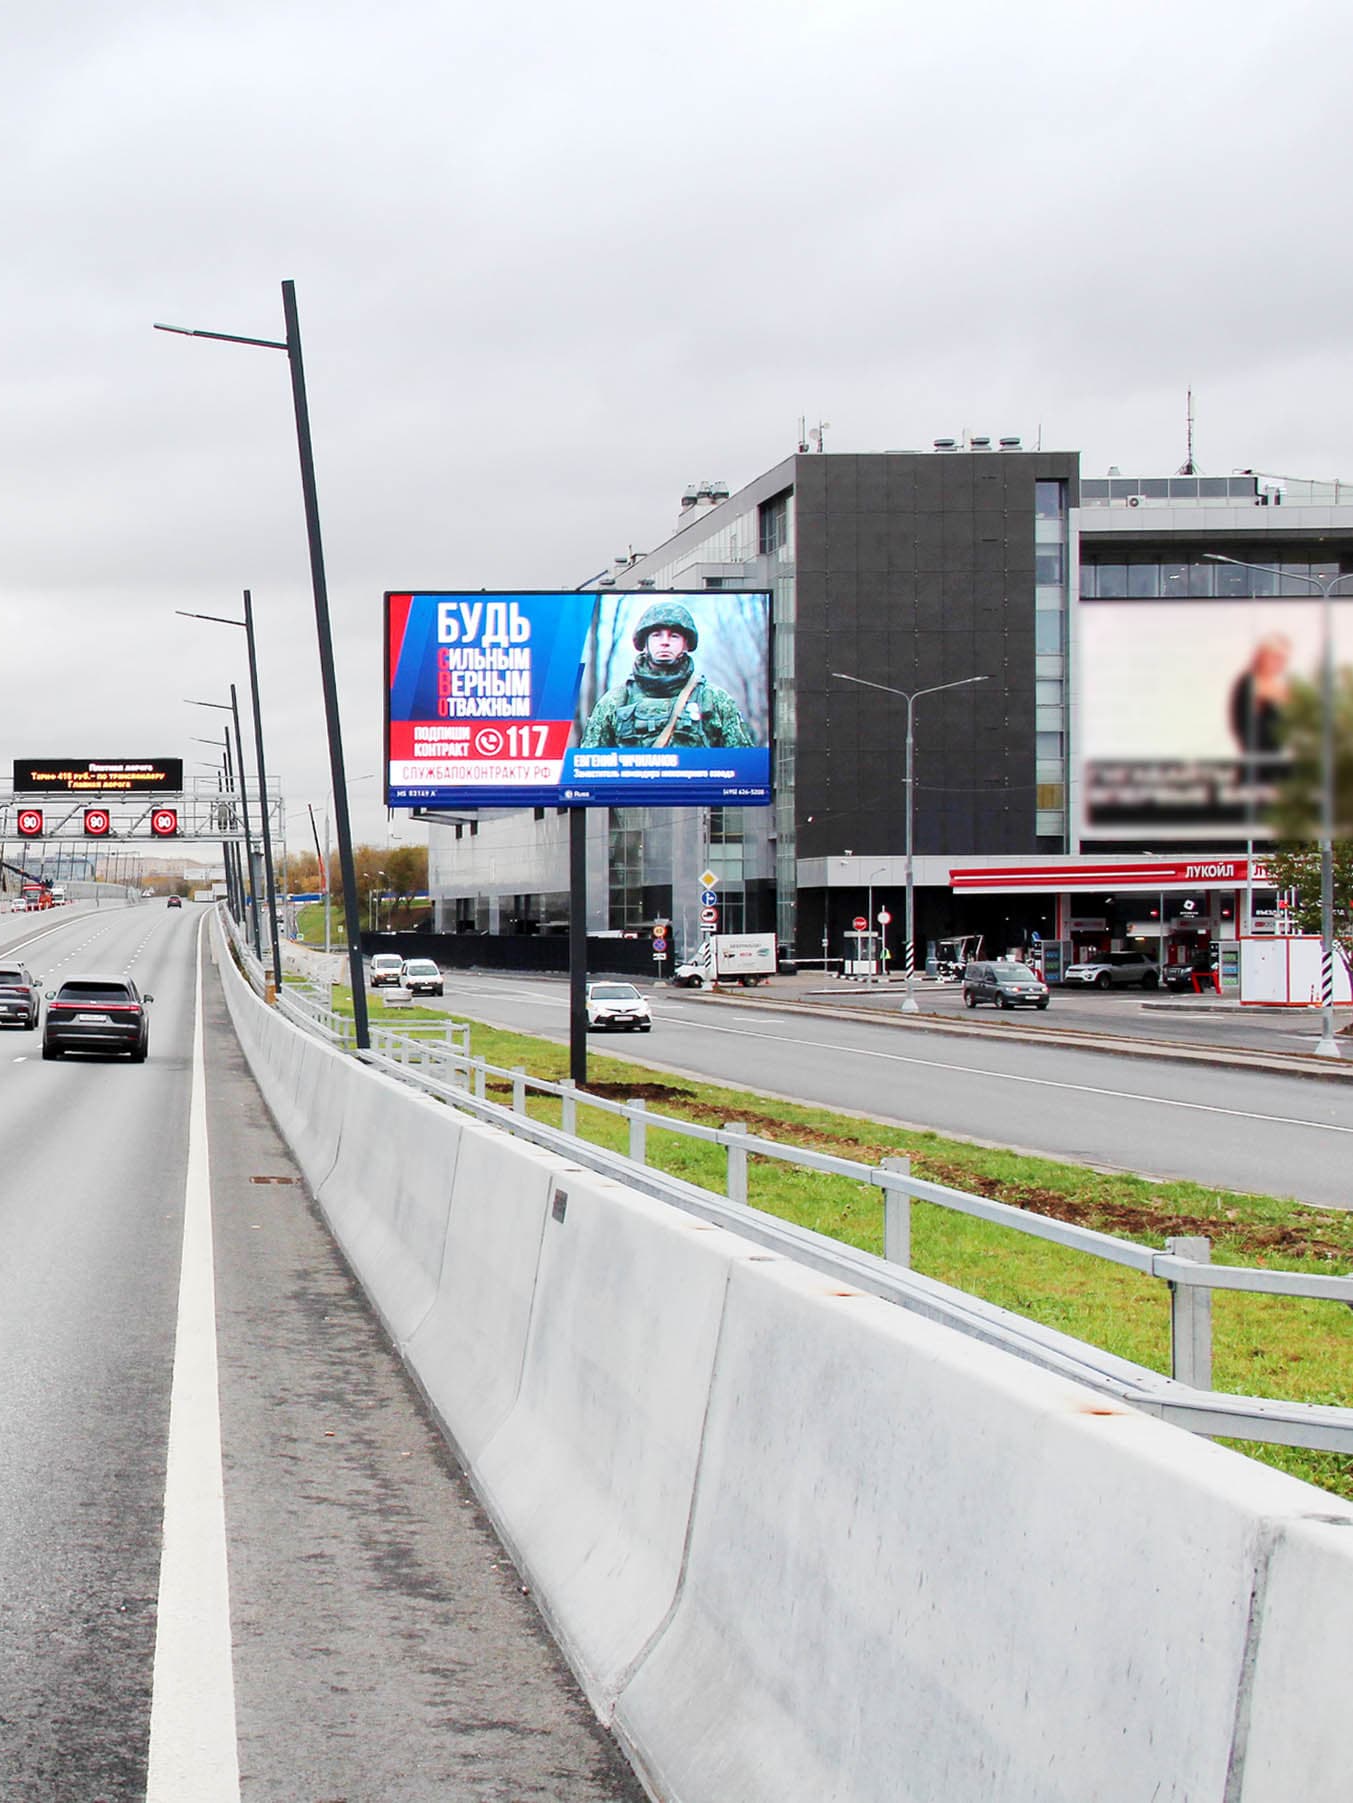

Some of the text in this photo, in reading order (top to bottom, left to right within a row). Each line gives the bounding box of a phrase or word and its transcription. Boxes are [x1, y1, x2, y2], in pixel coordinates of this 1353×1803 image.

[437, 602, 531, 648] БУДЬ
[438, 647, 531, 671] СИЛЬНЫМ
[438, 670, 531, 697] ВЕРНЫМ
[438, 697, 531, 717] ОТВАЖНЫМ
[414, 743, 470, 757] КОНТРАКТ
[506, 725, 549, 757] 117
[23, 816, 36, 828] 90
[89, 816, 102, 828] 90
[157, 816, 170, 828] 90
[1185, 862, 1235, 879] ЛУКОЙЛ
